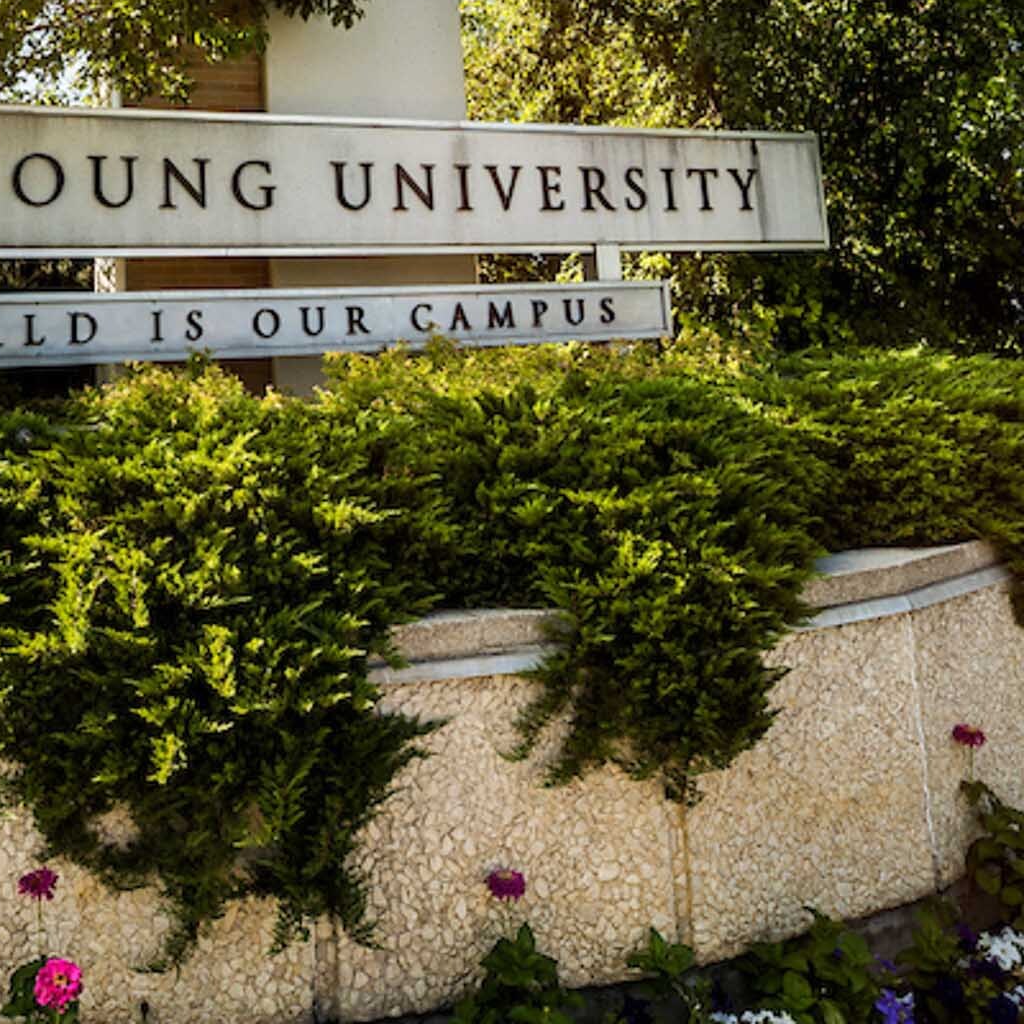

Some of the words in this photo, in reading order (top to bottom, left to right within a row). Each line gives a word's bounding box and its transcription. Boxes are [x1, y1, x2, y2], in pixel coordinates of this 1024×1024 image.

[332, 161, 760, 213] UNIVERSITY
[150, 308, 204, 343] IS
[252, 304, 373, 339] OUR
[410, 296, 617, 333] CAMPUS
